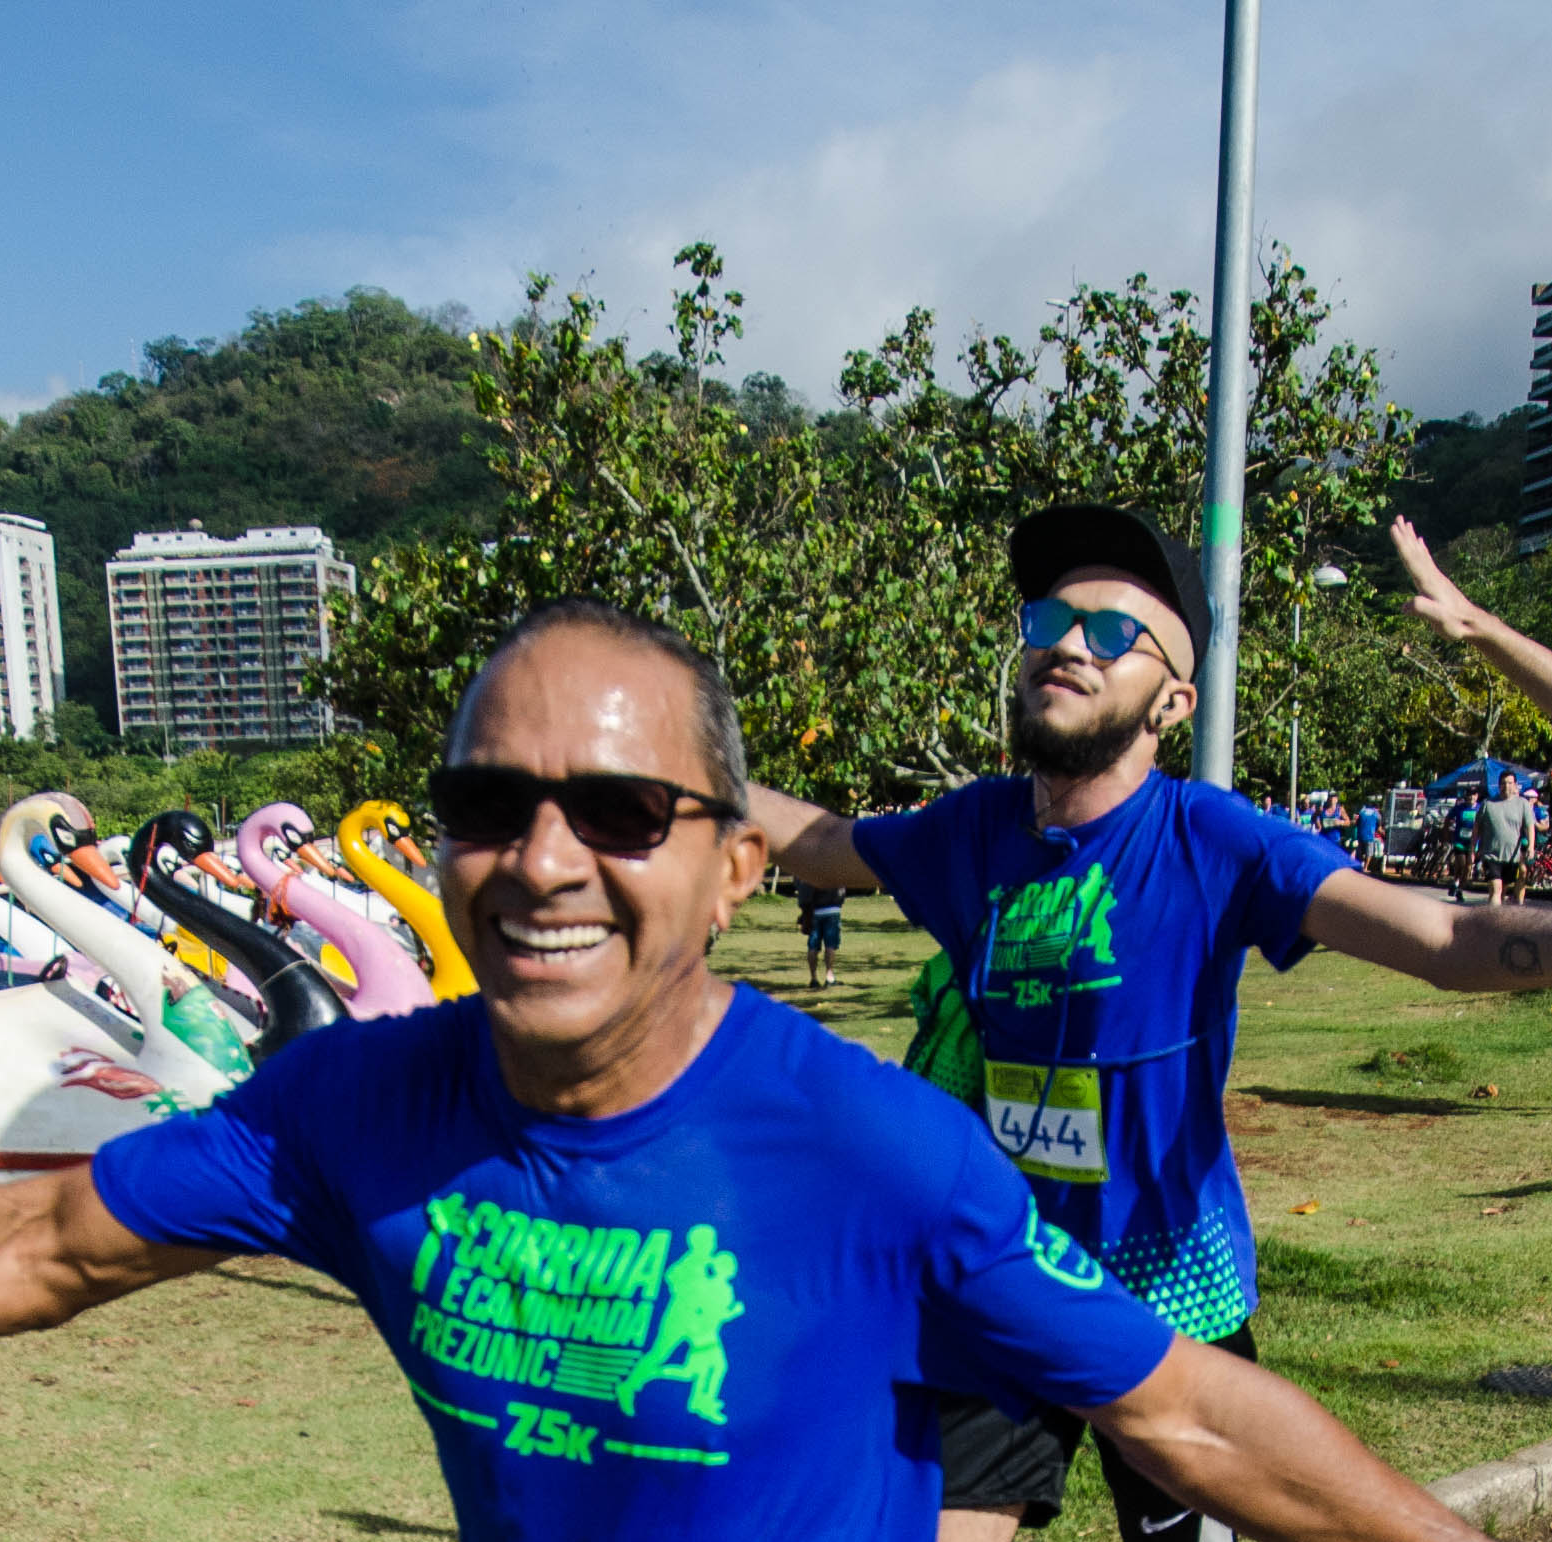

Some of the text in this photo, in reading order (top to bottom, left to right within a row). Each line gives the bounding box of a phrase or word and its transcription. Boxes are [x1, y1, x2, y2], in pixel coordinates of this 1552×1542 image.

[1000, 1105, 1087, 1156] 444
[454, 1201, 672, 1301] CORRIDA
[409, 1302, 561, 1388] PREZUNIC
[441, 1266, 655, 1348] E CAMINHADA
